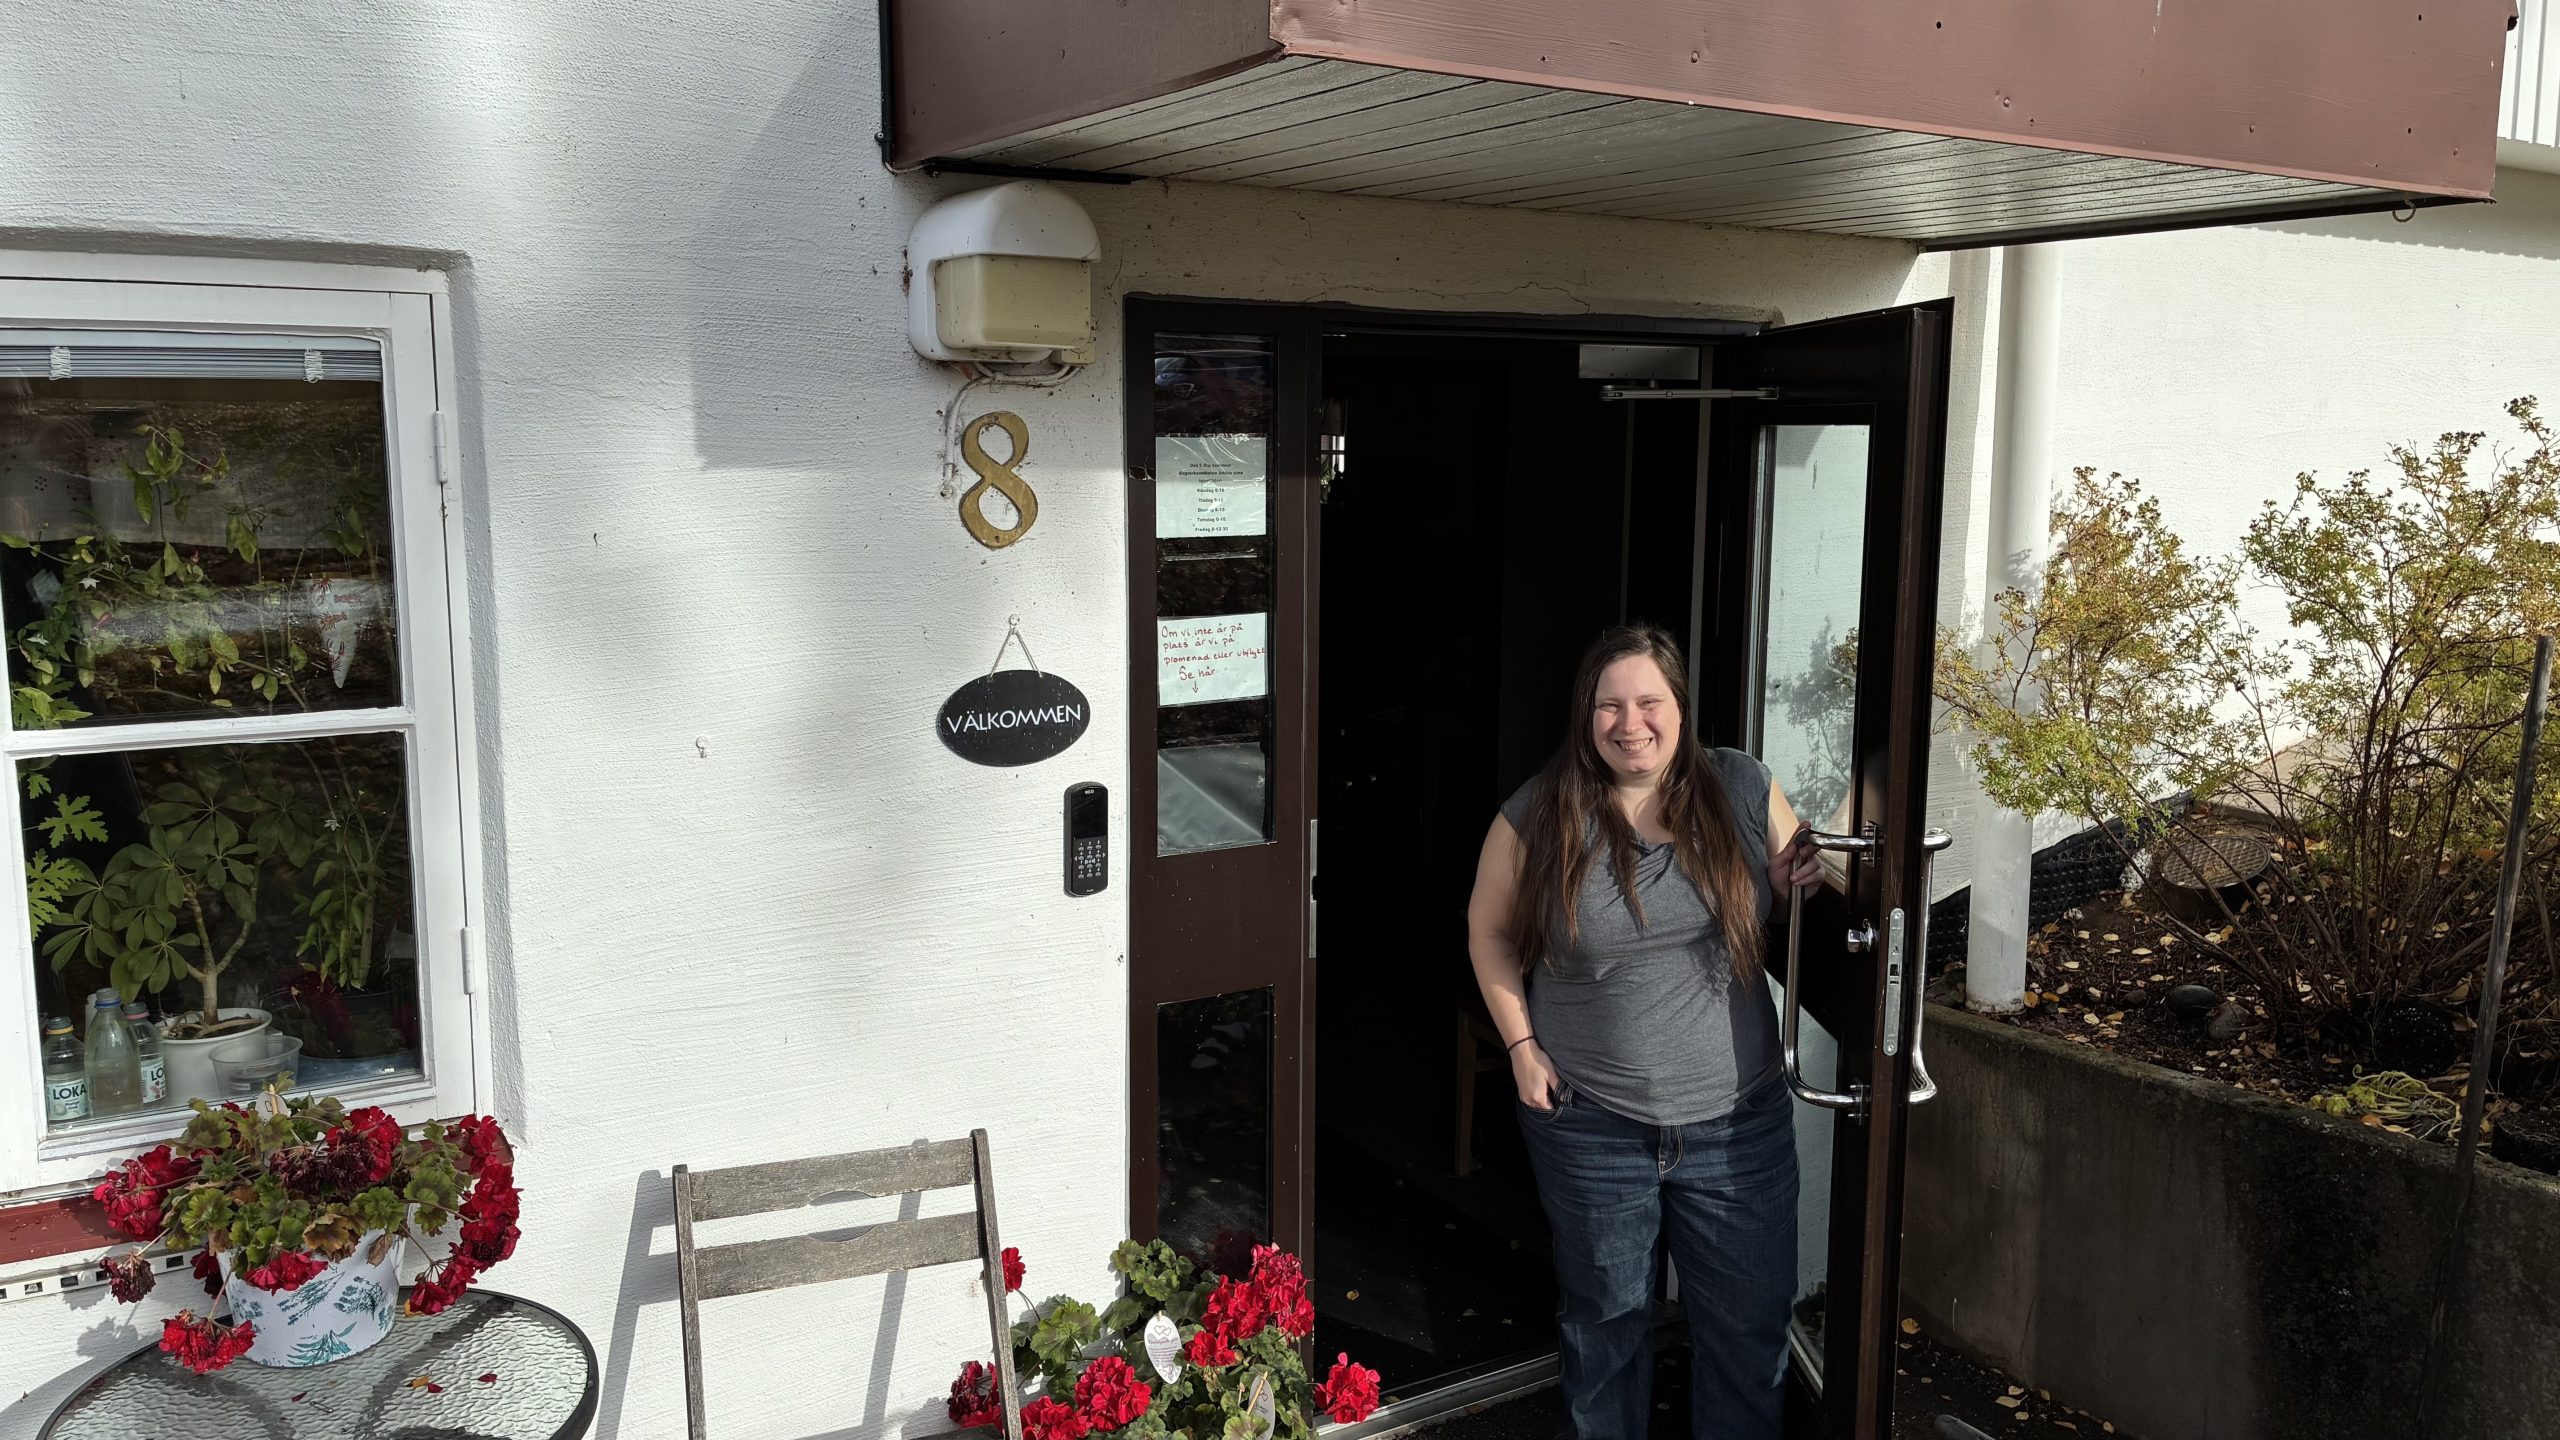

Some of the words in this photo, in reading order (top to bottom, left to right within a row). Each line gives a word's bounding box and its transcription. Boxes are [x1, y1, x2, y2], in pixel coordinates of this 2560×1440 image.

[959, 410, 1039, 551] 8
[1161, 625, 1178, 638] Om
[1180, 627, 1191, 637] vi
[1194, 627, 1213, 635] inte
[1230, 622, 1244, 634] på
[1163, 641, 1189, 653] plats
[1208, 637, 1218, 645] vi
[1222, 634, 1236, 647] på
[1163, 653, 1211, 667] promenad
[1213, 651, 1234, 660] eller
[1179, 665, 1195, 681] Se
[946, 703, 1081, 734] VÄLKOMMEN
[53, 1083, 87, 1100] LOKA
